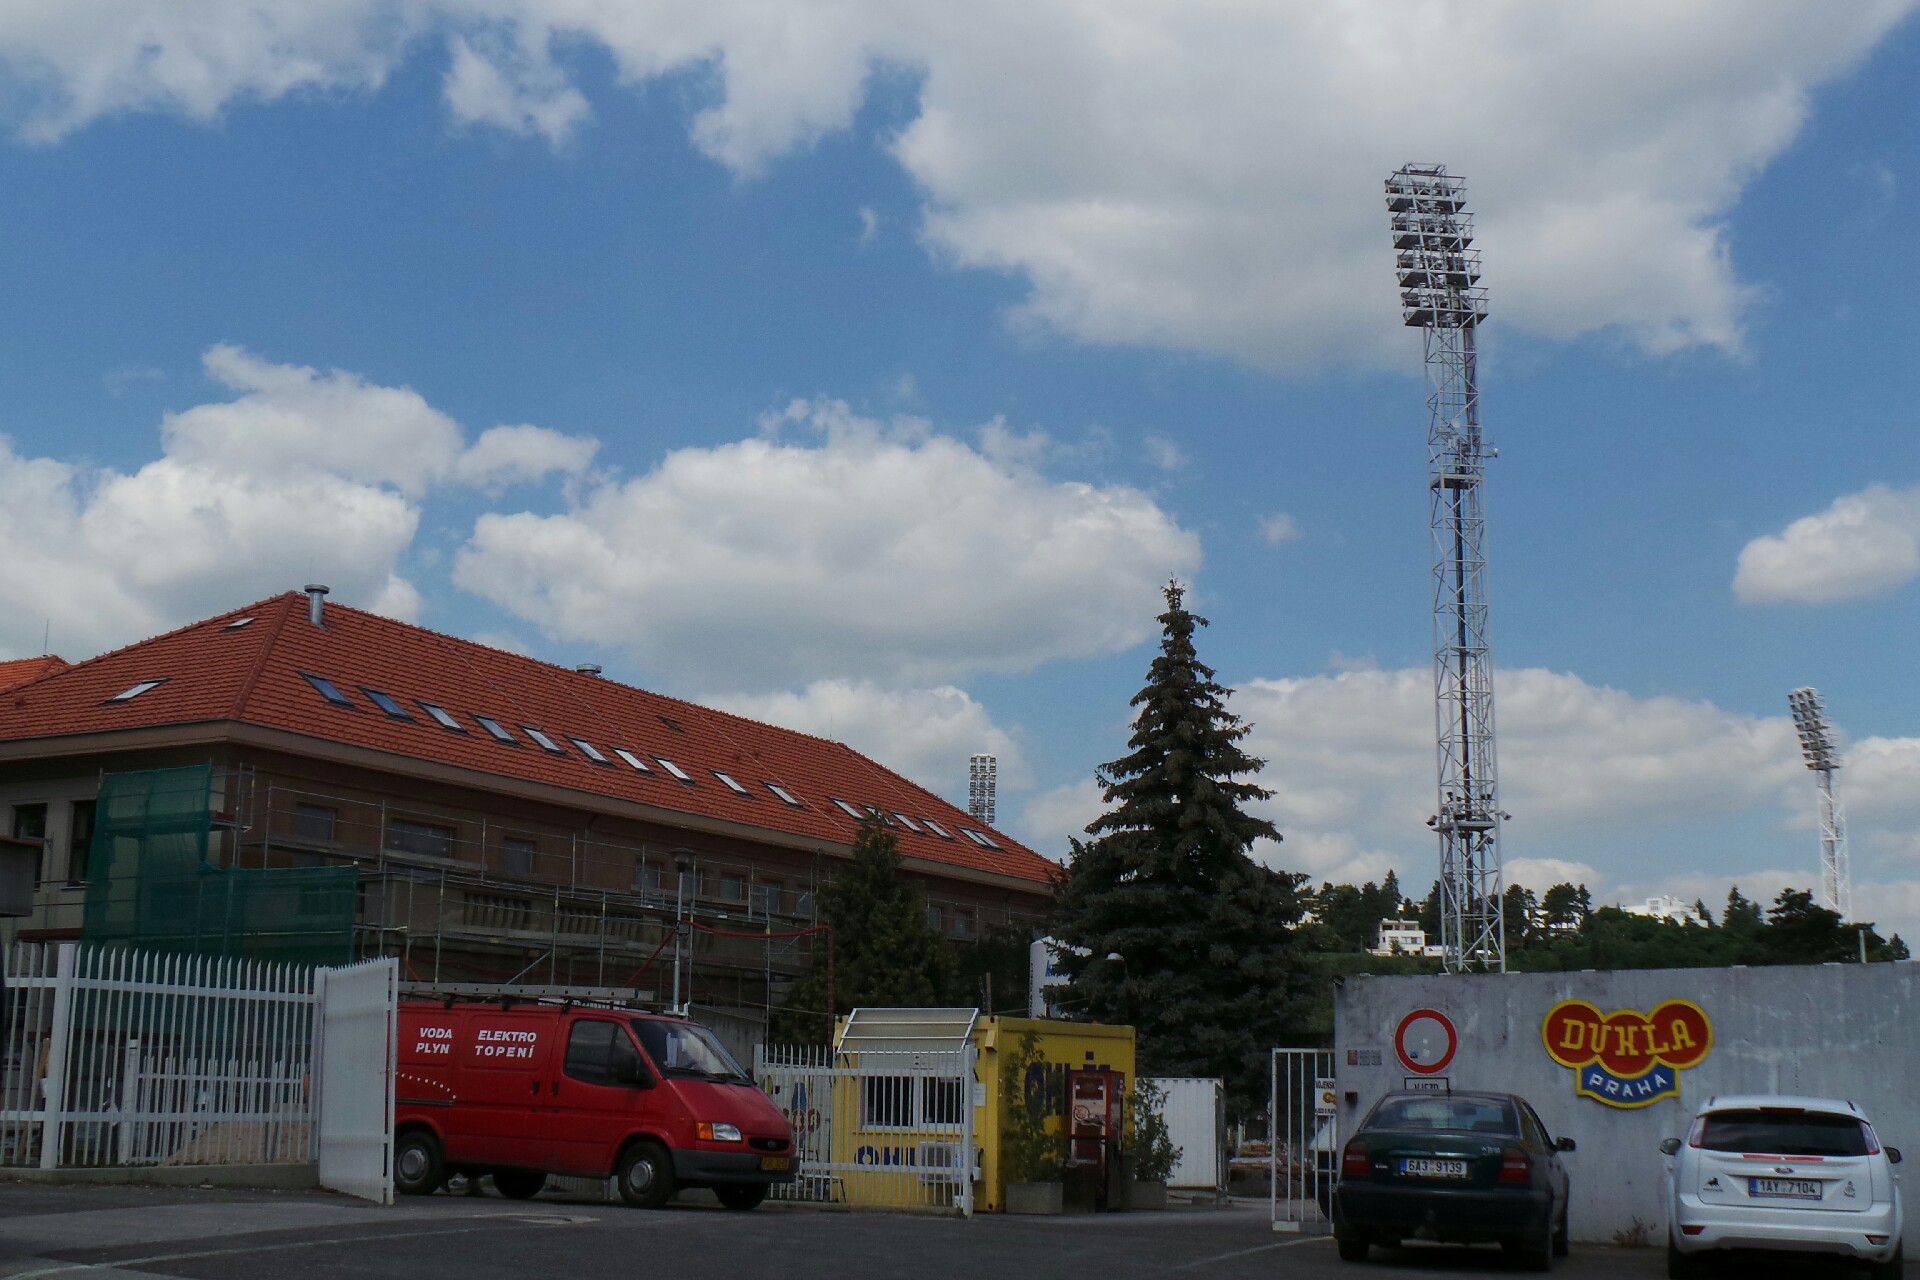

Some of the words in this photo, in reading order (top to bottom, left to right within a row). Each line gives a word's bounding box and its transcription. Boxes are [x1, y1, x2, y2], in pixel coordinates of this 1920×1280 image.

[419, 1027, 453, 1040] VODA
[477, 1029, 537, 1044] ELEKTRO
[1559, 1018, 1696, 1056] DUKLA
[415, 1042, 450, 1055] PLYN
[474, 1044, 535, 1059] TOPENÍ
[1588, 1073, 1667, 1097] PRAHA
[1408, 1160, 1429, 1172] 6A3
[1434, 1160, 1463, 1174] 9139
[1759, 1179, 1780, 1193] 1AY
[1788, 1181, 1817, 1195] 7104
